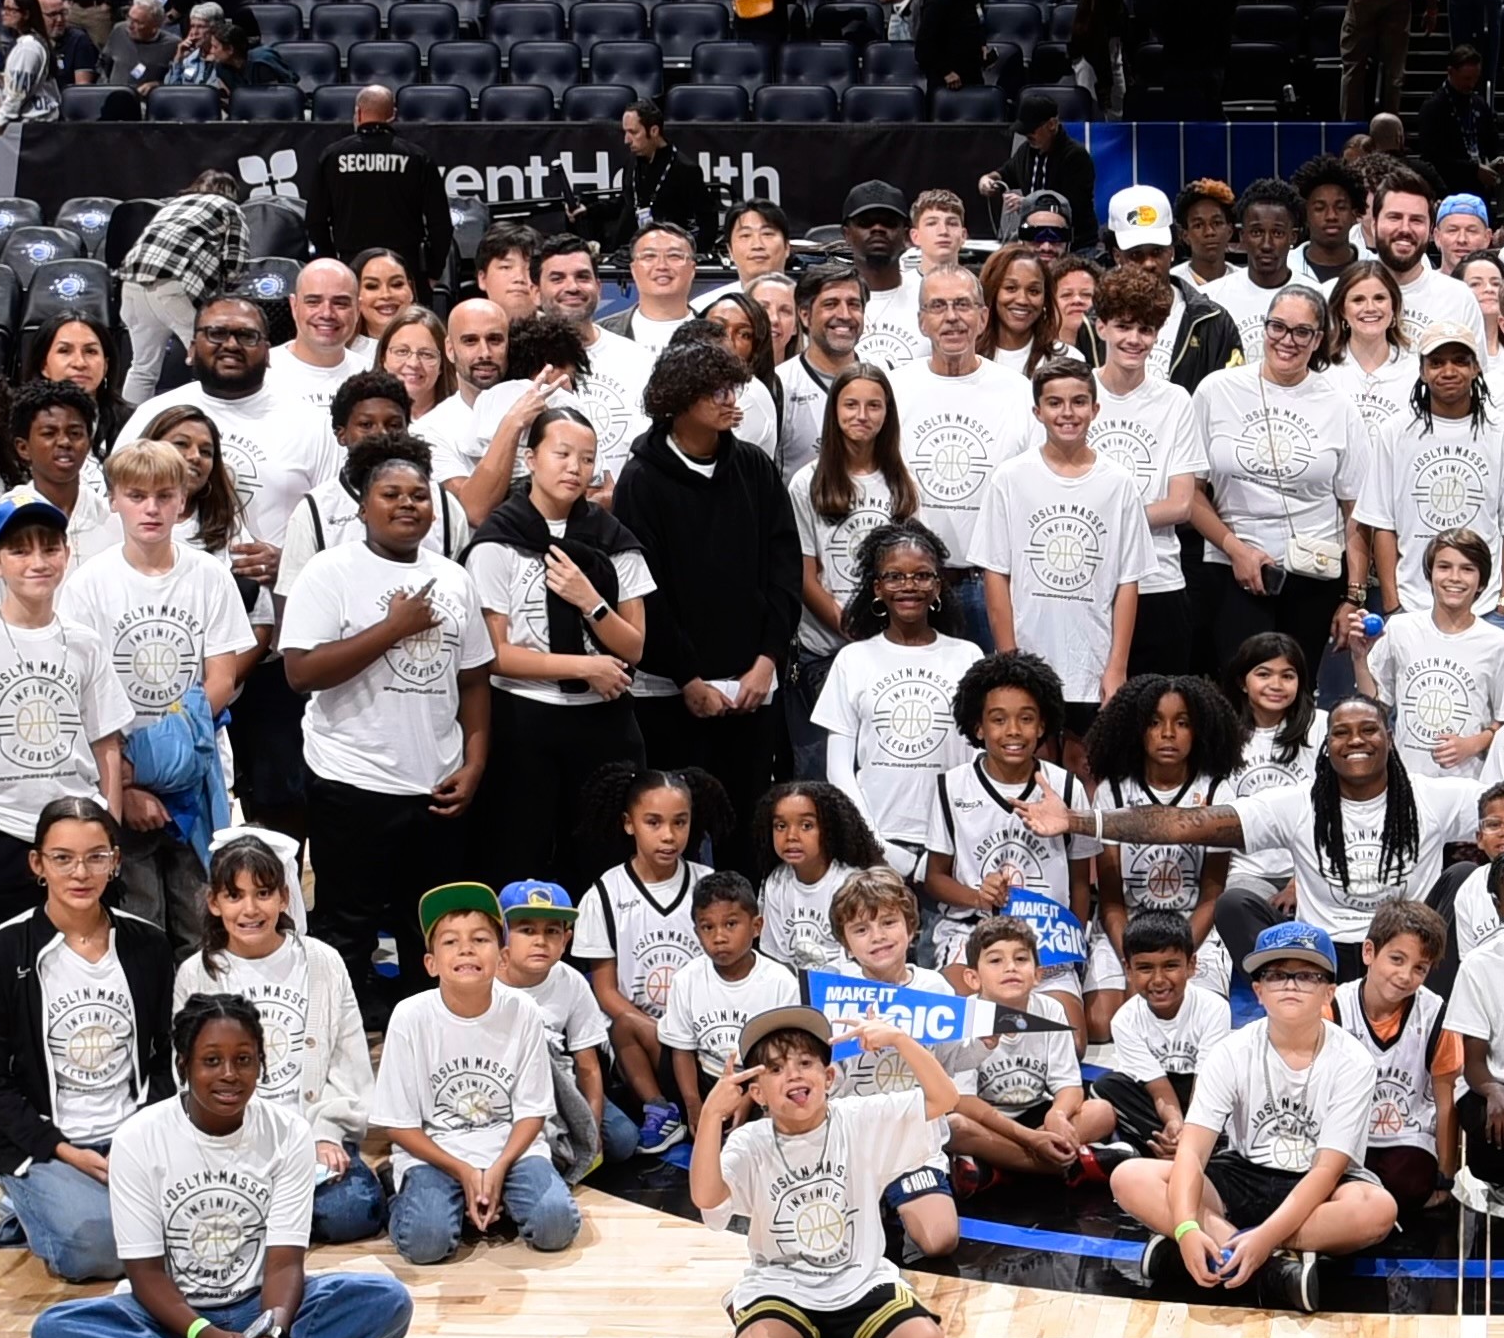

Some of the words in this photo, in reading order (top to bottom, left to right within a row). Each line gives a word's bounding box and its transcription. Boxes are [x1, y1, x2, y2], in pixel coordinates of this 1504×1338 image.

[338, 153, 409, 173] SECURITY
[913, 413, 951, 439] JOSLYN
[956, 414, 993, 444] MASSEY
[929, 434, 974, 450] INFINITE
[1414, 446, 1449, 472] JOSLYN
[1455, 447, 1489, 477] MASSEY
[1428, 465, 1473, 482] INFINITE
[927, 481, 972, 496] LEGACIES
[1029, 504, 1065, 529] JOSLYN
[1071, 504, 1107, 536] MASSEY
[1426, 510, 1468, 527] LEGACIES
[1043, 524, 1087, 540] INFINITE
[1041, 567, 1087, 585] LEGACIES
[116, 605, 156, 636] JOSLYN
[161, 604, 204, 636] MASSEY
[129, 629, 183, 648] INFINITE
[872, 668, 912, 695] JOSLYN
[919, 668, 955, 694] MASSEY
[1405, 658, 1439, 681] JOSLYN
[1445, 659, 1476, 691] MASSEY
[128, 683, 181, 701] LEGACIES
[889, 687, 936, 704] INFINITE
[1418, 678, 1458, 695] INFINITE
[10, 687, 63, 706] INFINITE
[11, 742, 67, 763] LEGACIES
[886, 736, 933, 753] LEGACIES
[976, 829, 1009, 861] JOSLYN
[1013, 829, 1050, 861] MASSEY
[1011, 901, 1046, 917] MAKE
[1046, 905, 1059, 918] IT
[825, 986, 874, 1002] MAKE
[875, 988, 897, 1003] IT
[823, 1001, 955, 1039] MGIC
[163, 1170, 212, 1207] JOSLYN
[219, 1170, 270, 1205] MASSEY
[184, 1199, 248, 1220] INFINITE
